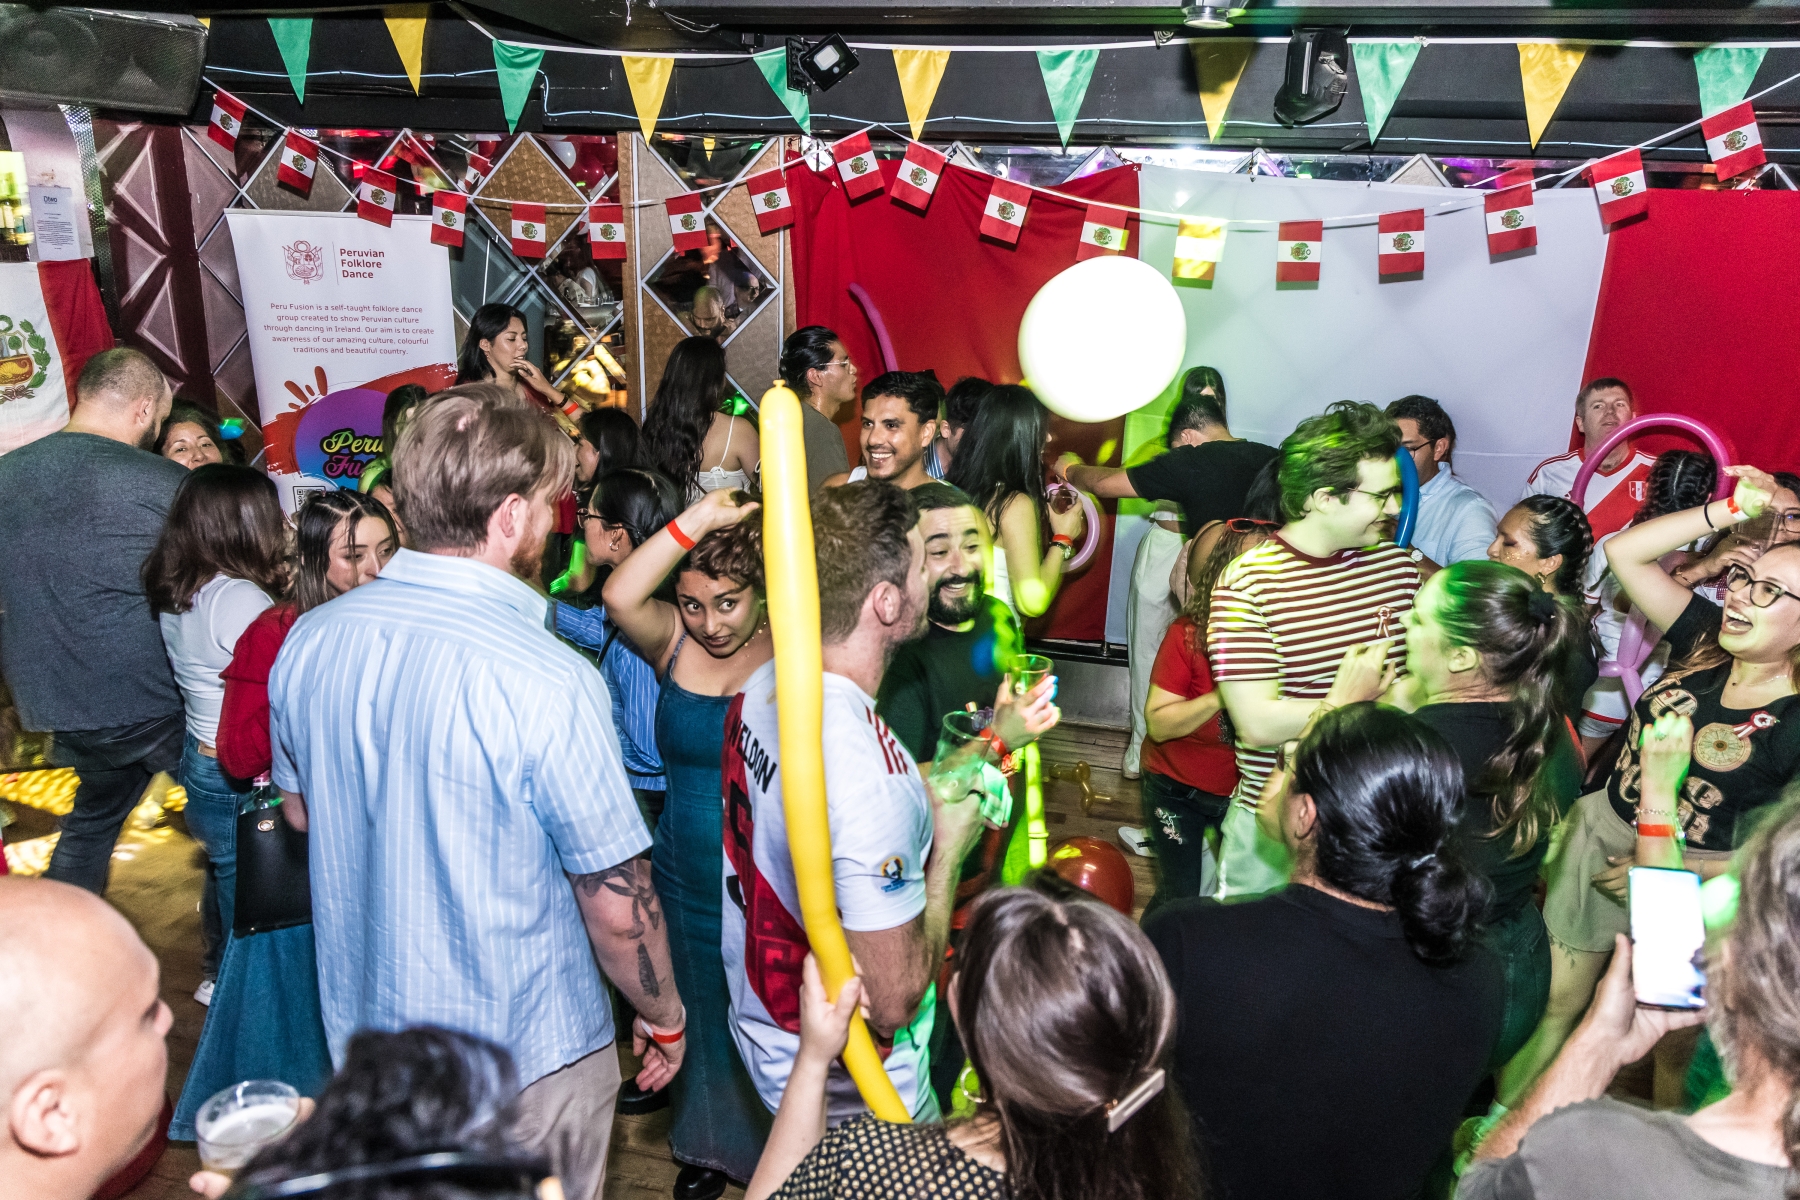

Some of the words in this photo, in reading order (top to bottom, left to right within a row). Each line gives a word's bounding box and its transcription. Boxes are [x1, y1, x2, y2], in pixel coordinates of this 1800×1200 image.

[340, 248, 385, 258] Peruvian
[341, 259, 382, 268] Folklore
[342, 269, 374, 279] Dance
[289, 303, 314, 311] Fusion
[330, 304, 371, 312] self-taught
[372, 305, 400, 313] folklore
[361, 315, 393, 323] Peruvian
[263, 324, 293, 332] through
[294, 325, 325, 333] dancing
[334, 325, 363, 333] Ireland.
[312, 335, 321, 343] of
[368, 337, 396, 345] culture,
[379, 348, 409, 356] country.
[321, 429, 383, 454] Peru
[729, 712, 778, 794] WELDON
